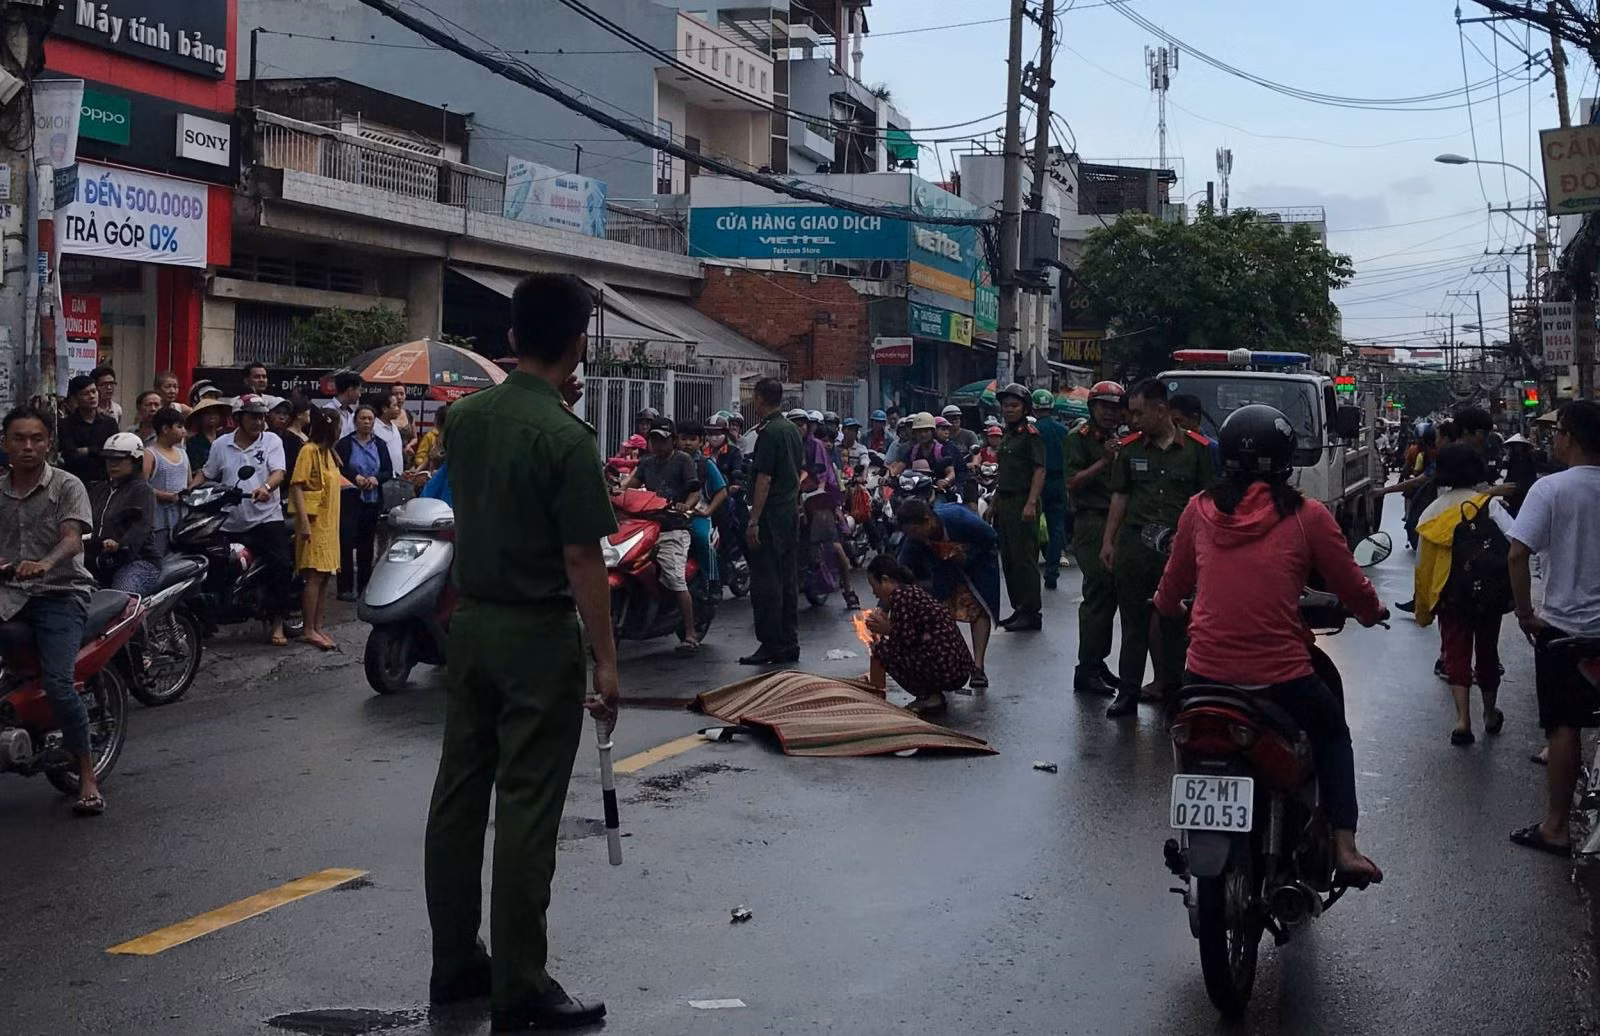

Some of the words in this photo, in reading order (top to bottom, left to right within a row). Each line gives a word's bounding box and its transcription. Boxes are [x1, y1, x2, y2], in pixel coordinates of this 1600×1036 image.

[75, 0, 123, 43] Máy
[128, 17, 170, 50] tính
[177, 31, 227, 73] bảng
[184, 129, 228, 151] SONY
[85, 172, 122, 209] ĐẾN
[125, 188, 203, 220] 500.000Đ
[66, 210, 99, 243] TRẢ
[104, 216, 145, 247] GÓP
[150, 224, 178, 252] 0%
[716, 212, 747, 230] CỬA
[751, 213, 795, 230] HÀNG
[800, 215, 838, 230] GIAO
[843, 215, 881, 234] DỊCH
[802, 247, 821, 255] Store
[1176, 803, 1247, 828] 020.53
